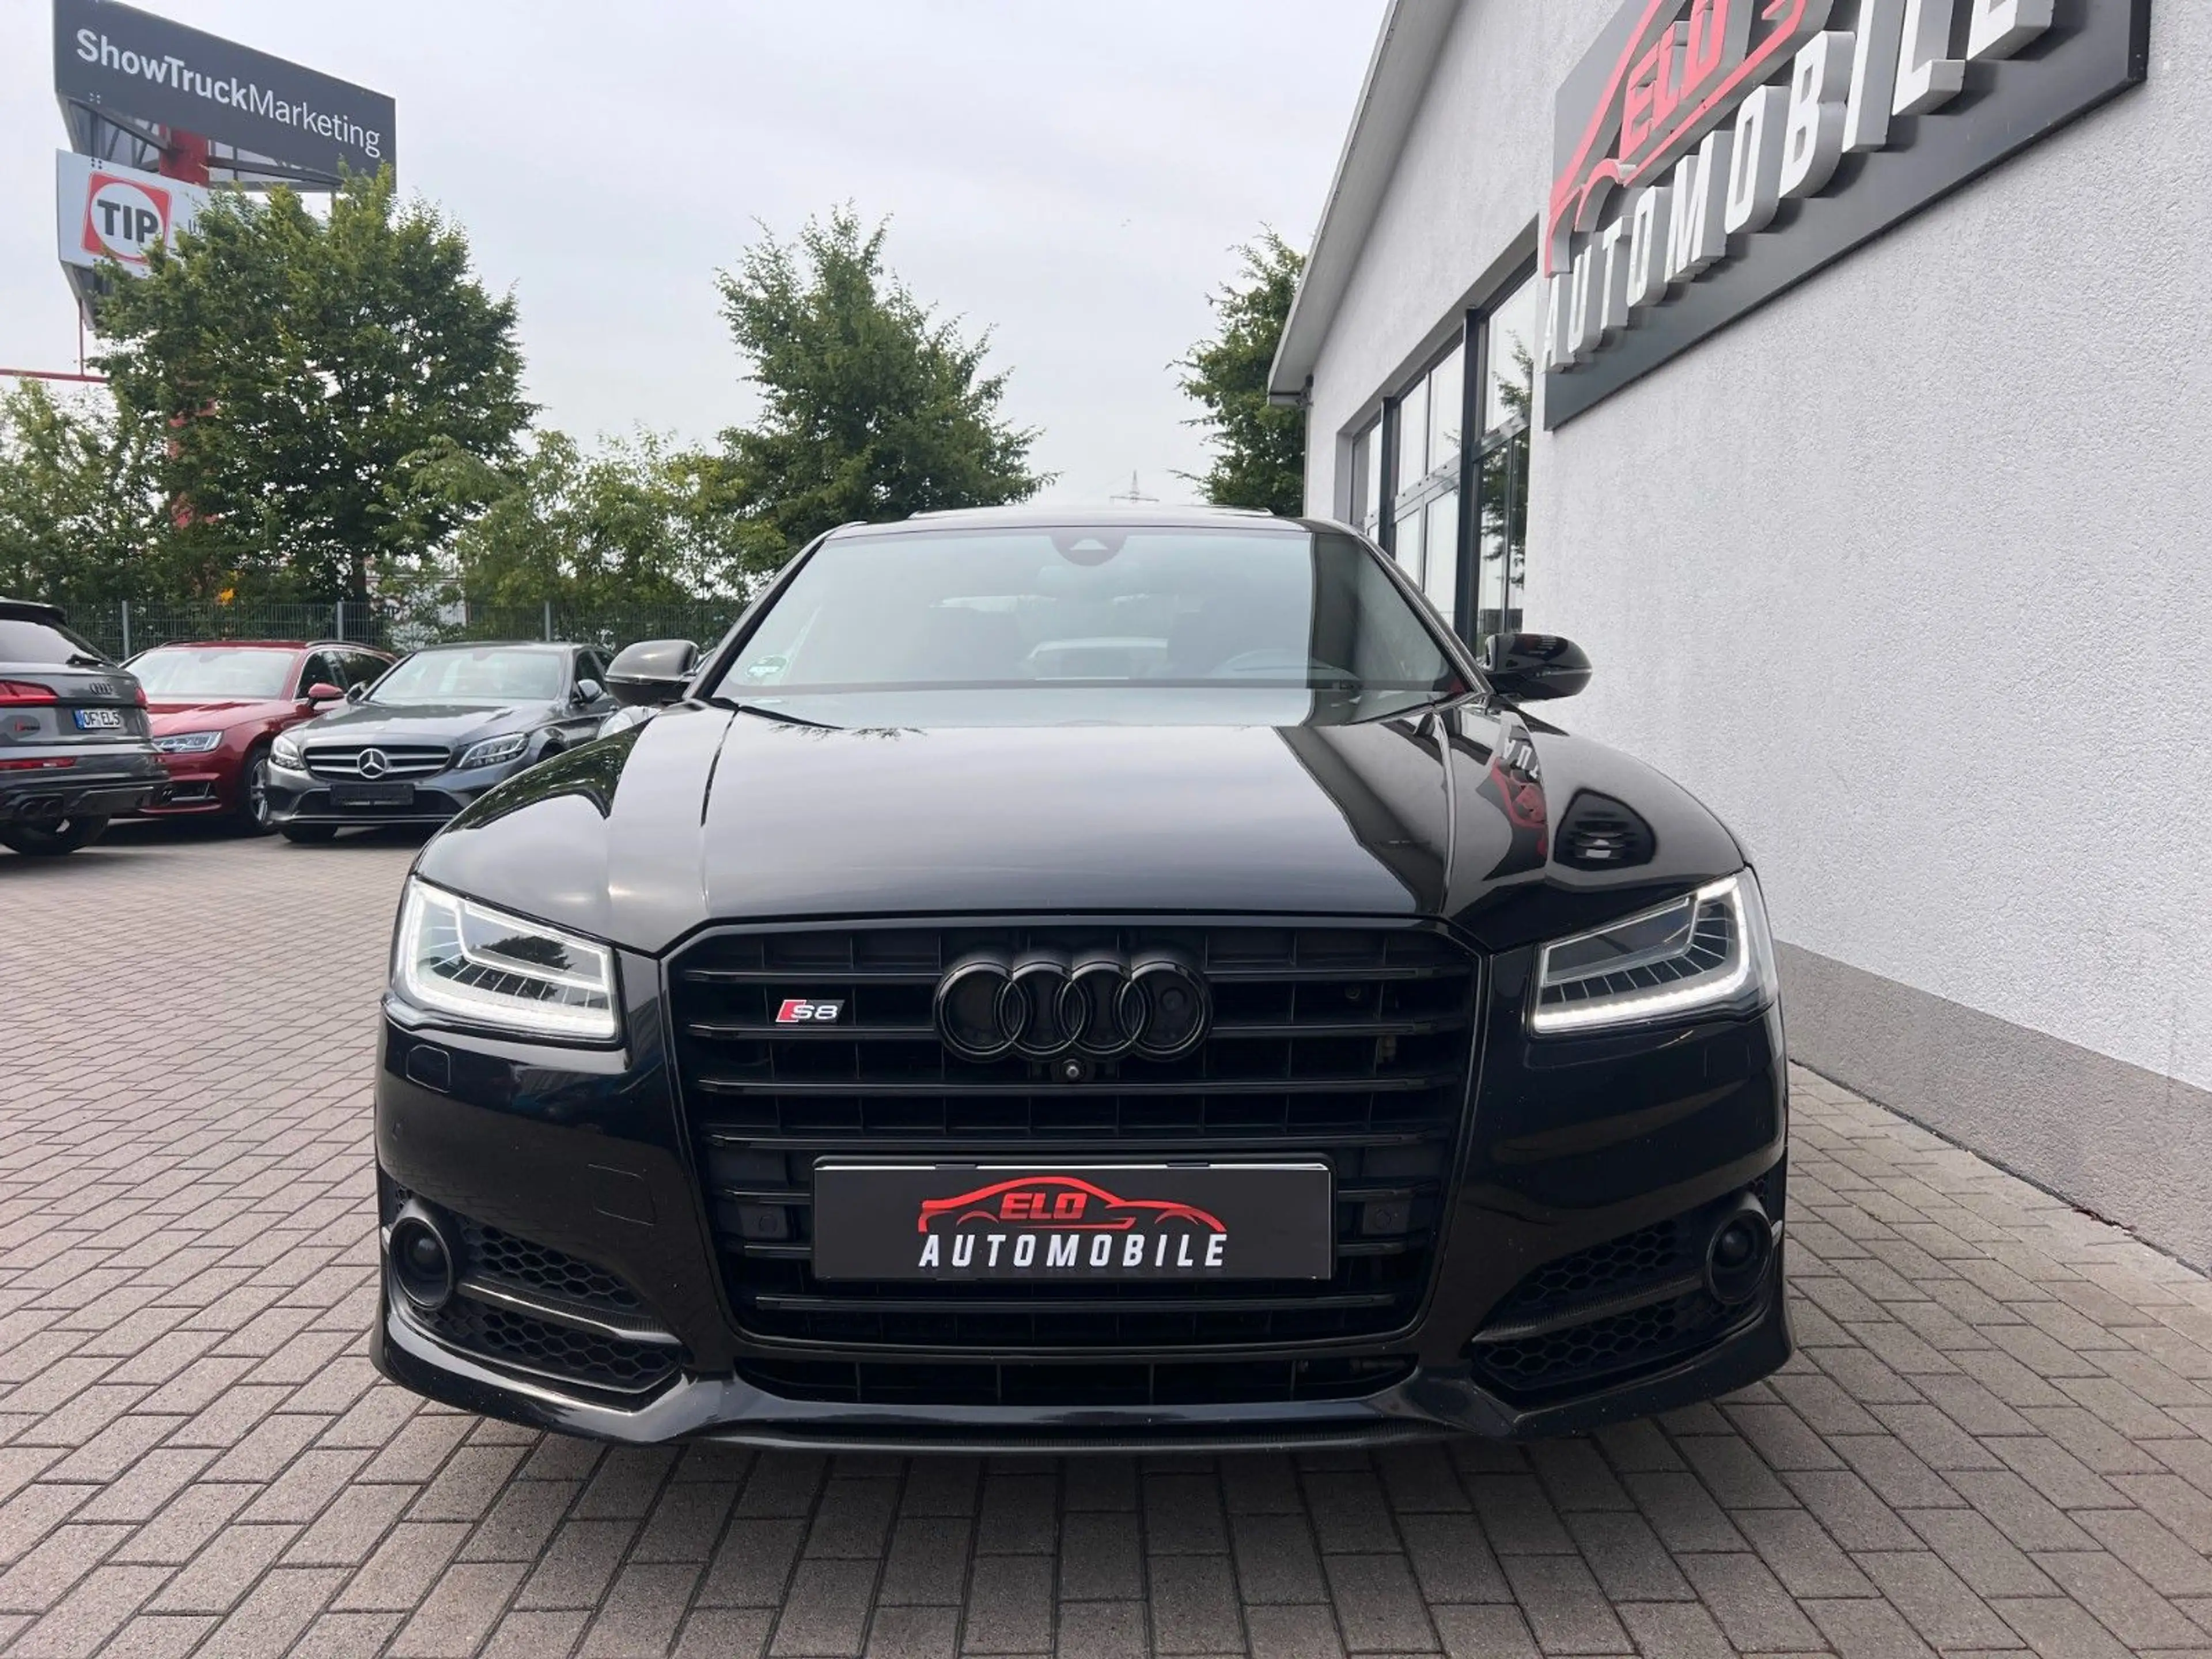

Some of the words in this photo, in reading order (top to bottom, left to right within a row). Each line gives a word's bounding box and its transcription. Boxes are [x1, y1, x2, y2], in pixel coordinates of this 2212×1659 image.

[76, 29, 381, 159] ShowTruckMarketing
[1535, 0, 2018, 374] AUTOMOBIL
[97, 199, 159, 243] TIP
[790, 1004, 839, 1020] S8
[999, 1193, 1088, 1219] ELO
[918, 1234, 1228, 1267] AUTOMOBILE
